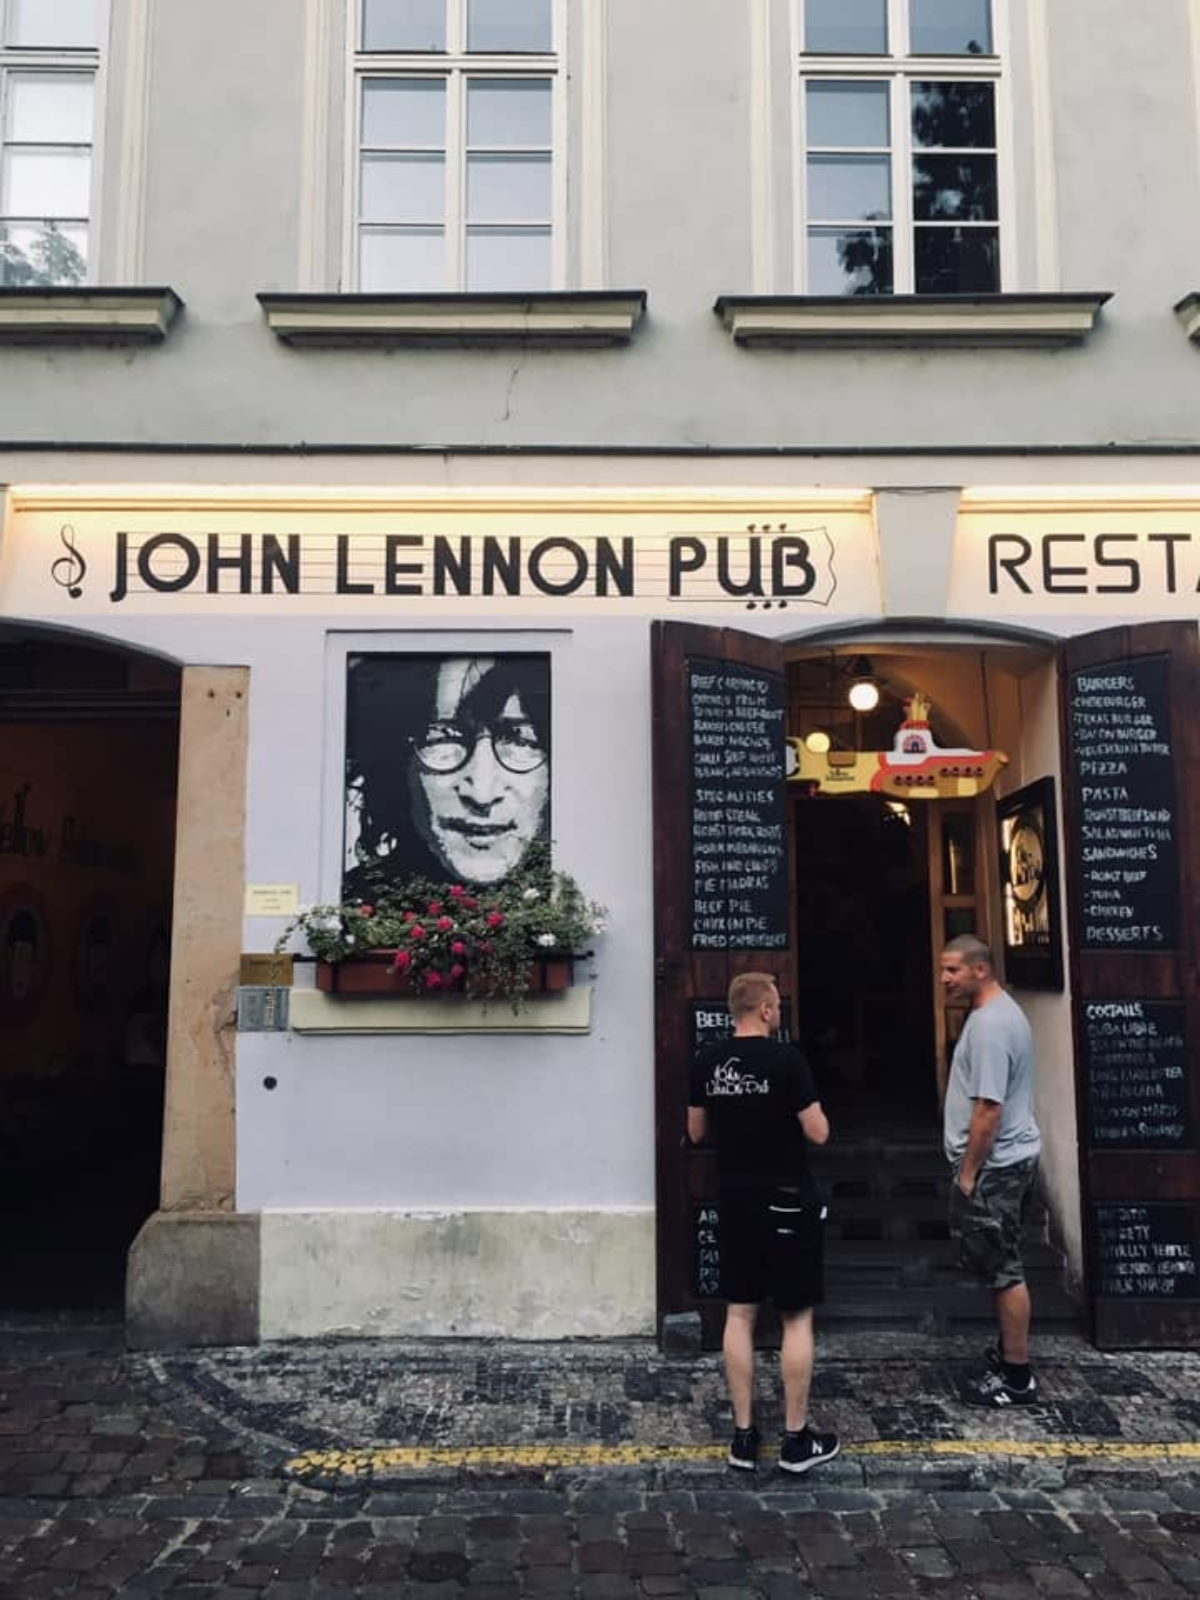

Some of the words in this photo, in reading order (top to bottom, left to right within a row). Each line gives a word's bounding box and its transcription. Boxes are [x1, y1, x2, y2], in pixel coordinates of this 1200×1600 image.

[110, 531, 300, 602] JOHN
[336, 533, 634, 597] LENNON
[988, 533, 1200, 595] REST
[1080, 761, 1128, 776] PIZZA
[1081, 786, 1129, 802] PASTA
[1086, 925, 1164, 942] DESSERTS
